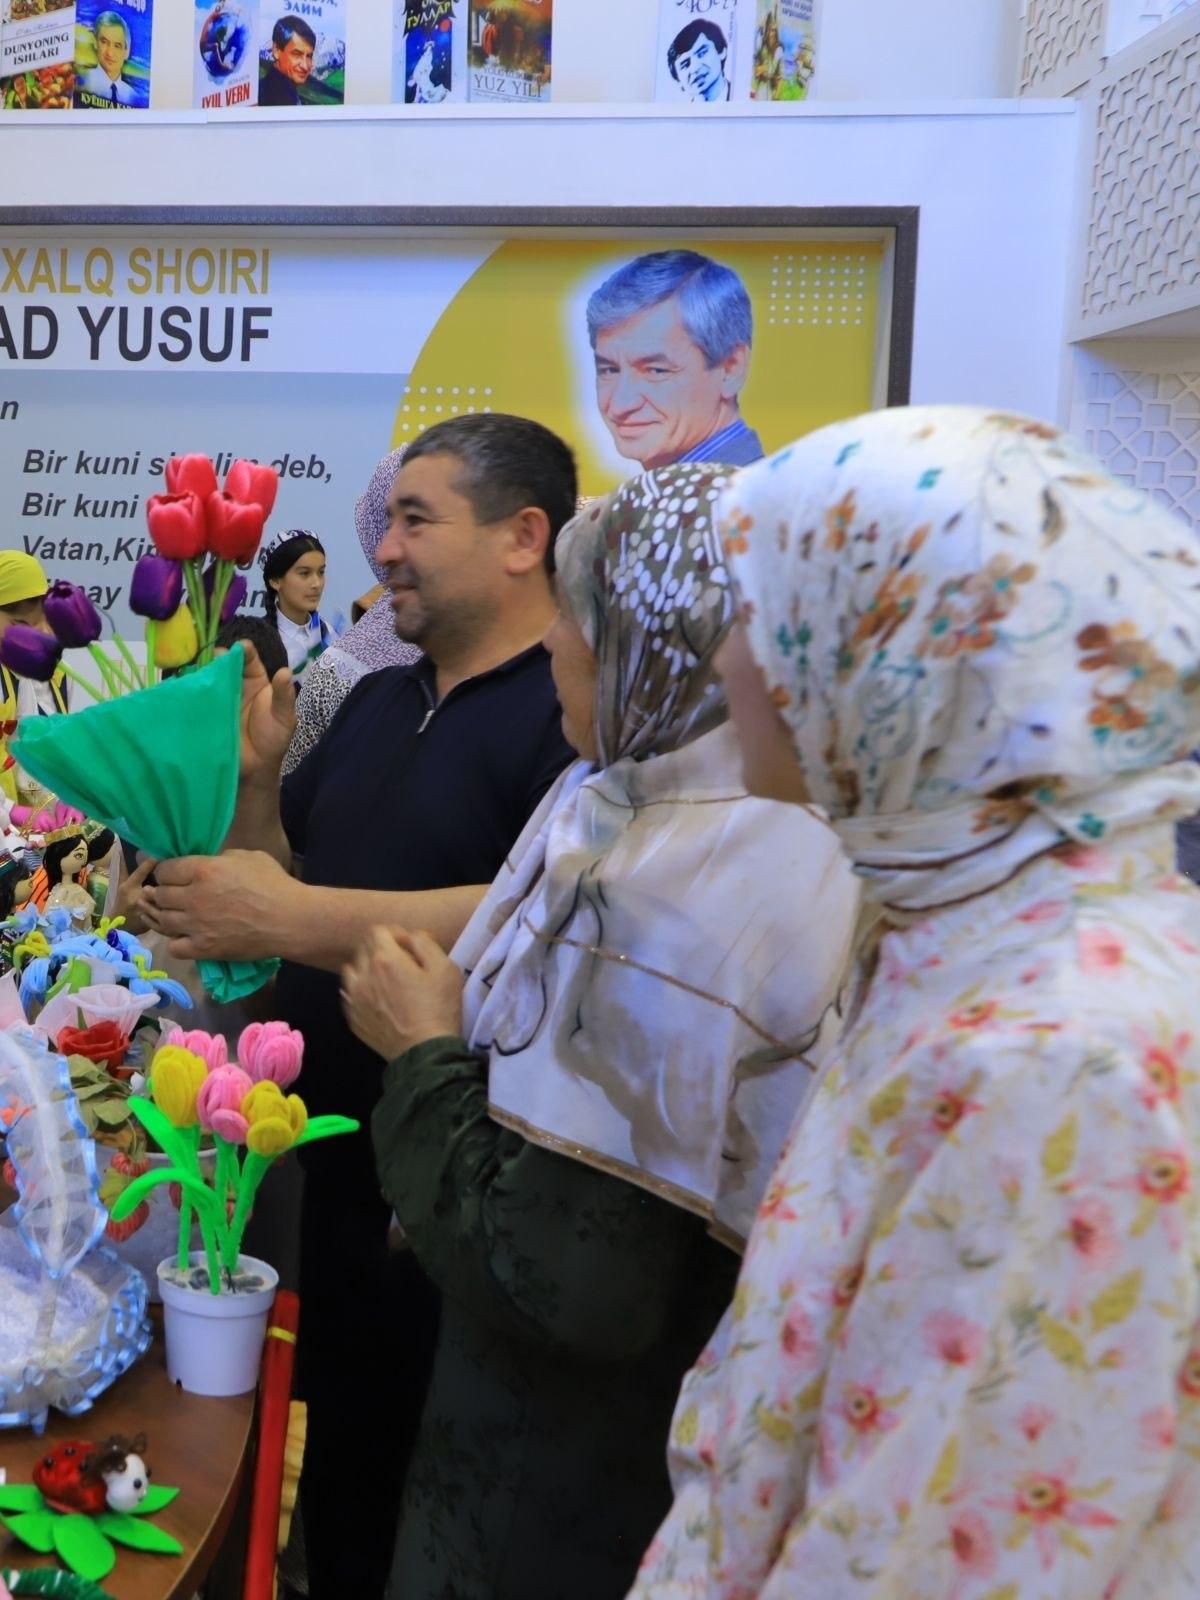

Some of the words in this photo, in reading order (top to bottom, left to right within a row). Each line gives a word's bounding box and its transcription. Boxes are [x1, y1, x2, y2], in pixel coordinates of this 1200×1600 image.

[4, 32, 70, 56] DUNYONING
[13, 47, 60, 66] ISHLARI
[225, 82, 251, 107] VERN
[0, 248, 114, 297] XALQ
[128, 249, 270, 295] SHOIRI
[77, 306, 273, 362] YUSUF
[22, 449, 68, 474] Bir
[75, 450, 141, 475] kuni
[270, 453, 332, 483] deb,
[21, 492, 67, 517] Bir
[73, 493, 139, 518] kuni
